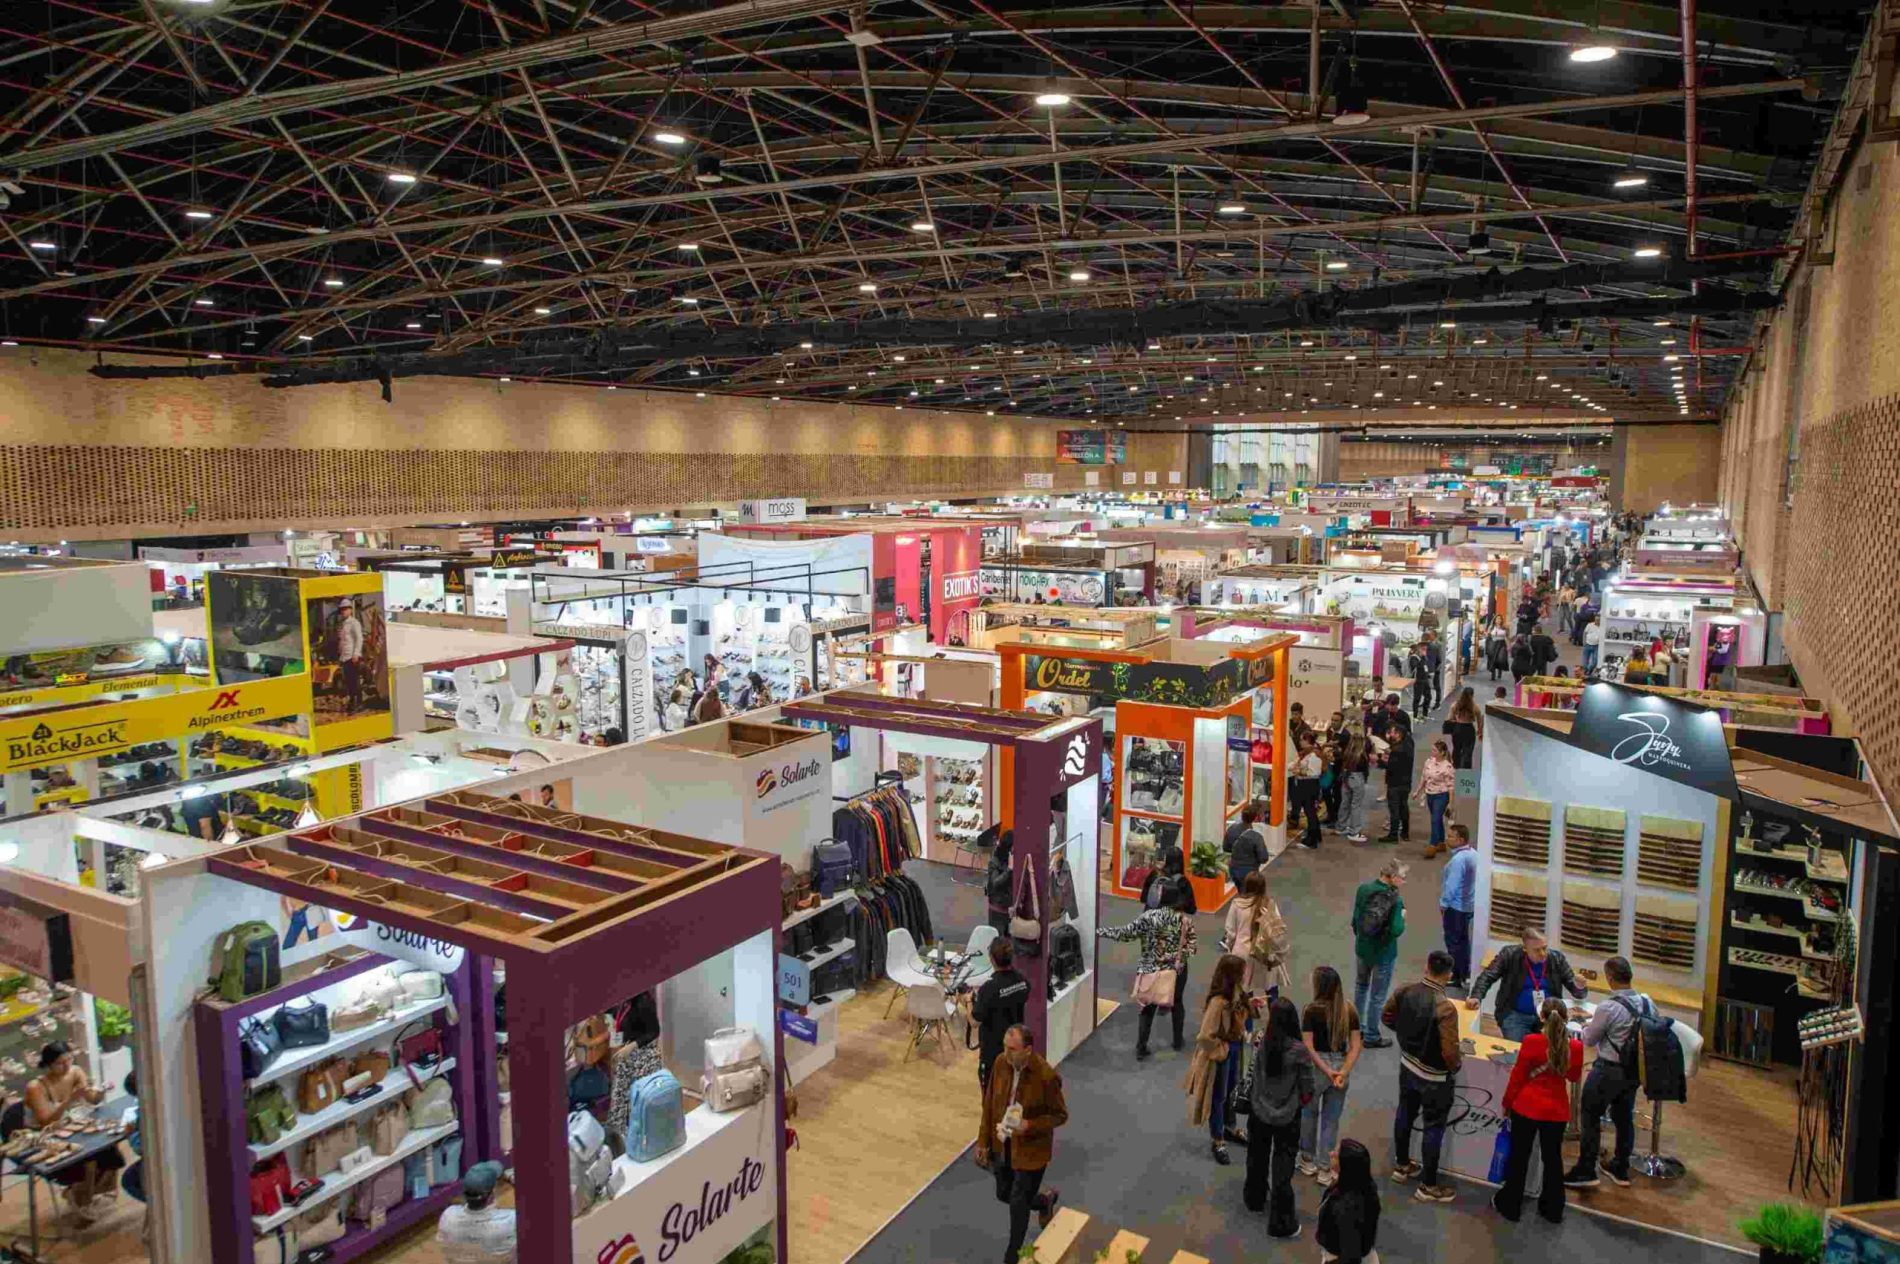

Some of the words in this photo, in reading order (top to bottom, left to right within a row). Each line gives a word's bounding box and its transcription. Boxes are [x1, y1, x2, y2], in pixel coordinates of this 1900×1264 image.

[768, 502, 795, 514] moss
[545, 626, 588, 637] CALZADO
[102, 677, 159, 693] Elemental
[1037, 658, 1091, 688] Ordel
[631, 668, 645, 724] CALZADO
[188, 707, 265, 728] Alpinextrem
[9, 727, 127, 760] BlackJack
[780, 758, 820, 788] Solarte
[784, 972, 802, 988] 501
[658, 1157, 766, 1262] Solarte
